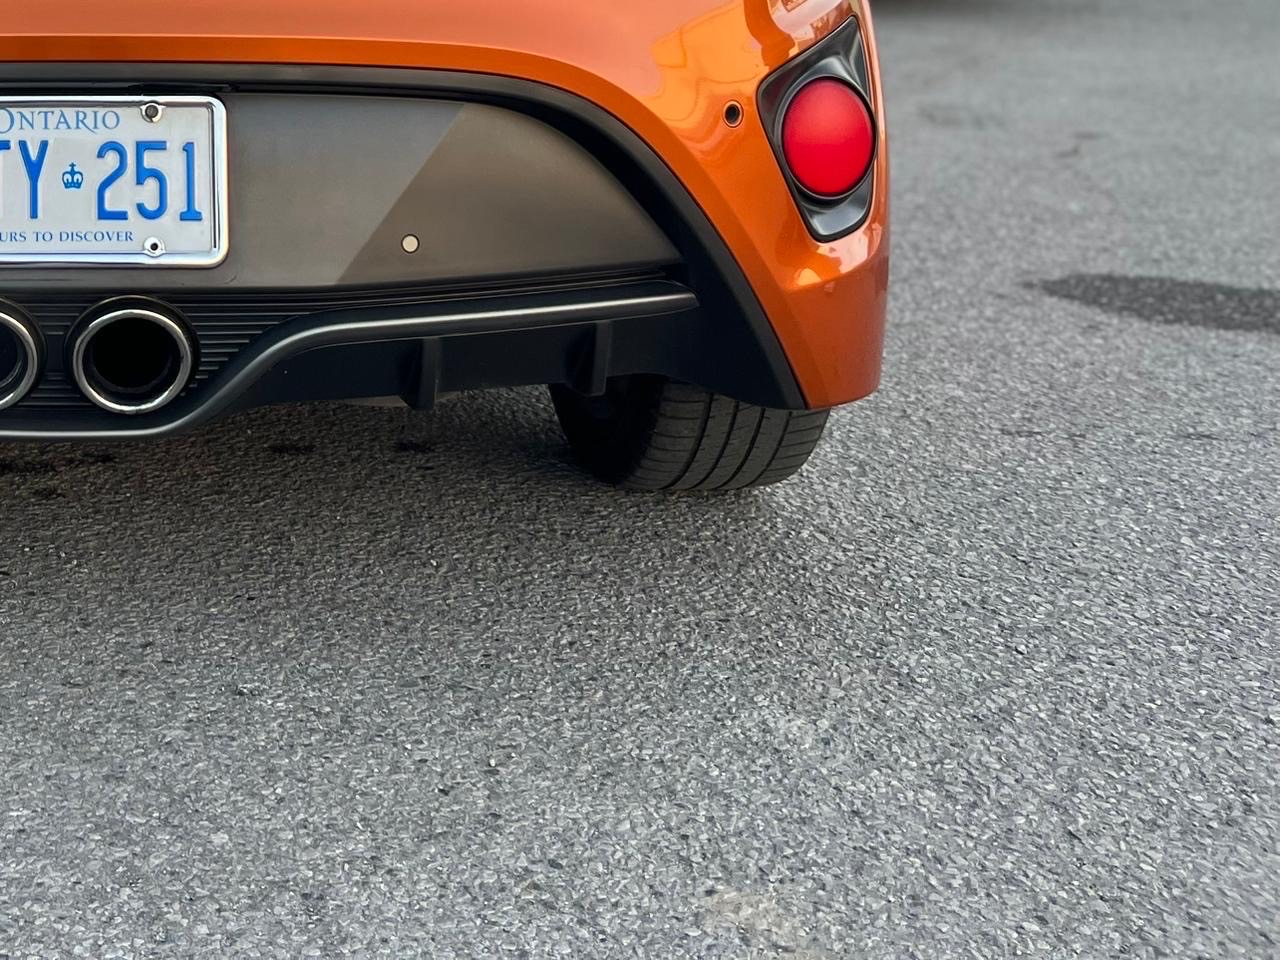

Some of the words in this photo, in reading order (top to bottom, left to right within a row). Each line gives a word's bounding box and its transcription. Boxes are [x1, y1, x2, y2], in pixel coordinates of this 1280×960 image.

[97, 140, 202, 221] 251
[33, 231, 53, 242] TO
[59, 231, 134, 242] DISCOVER
